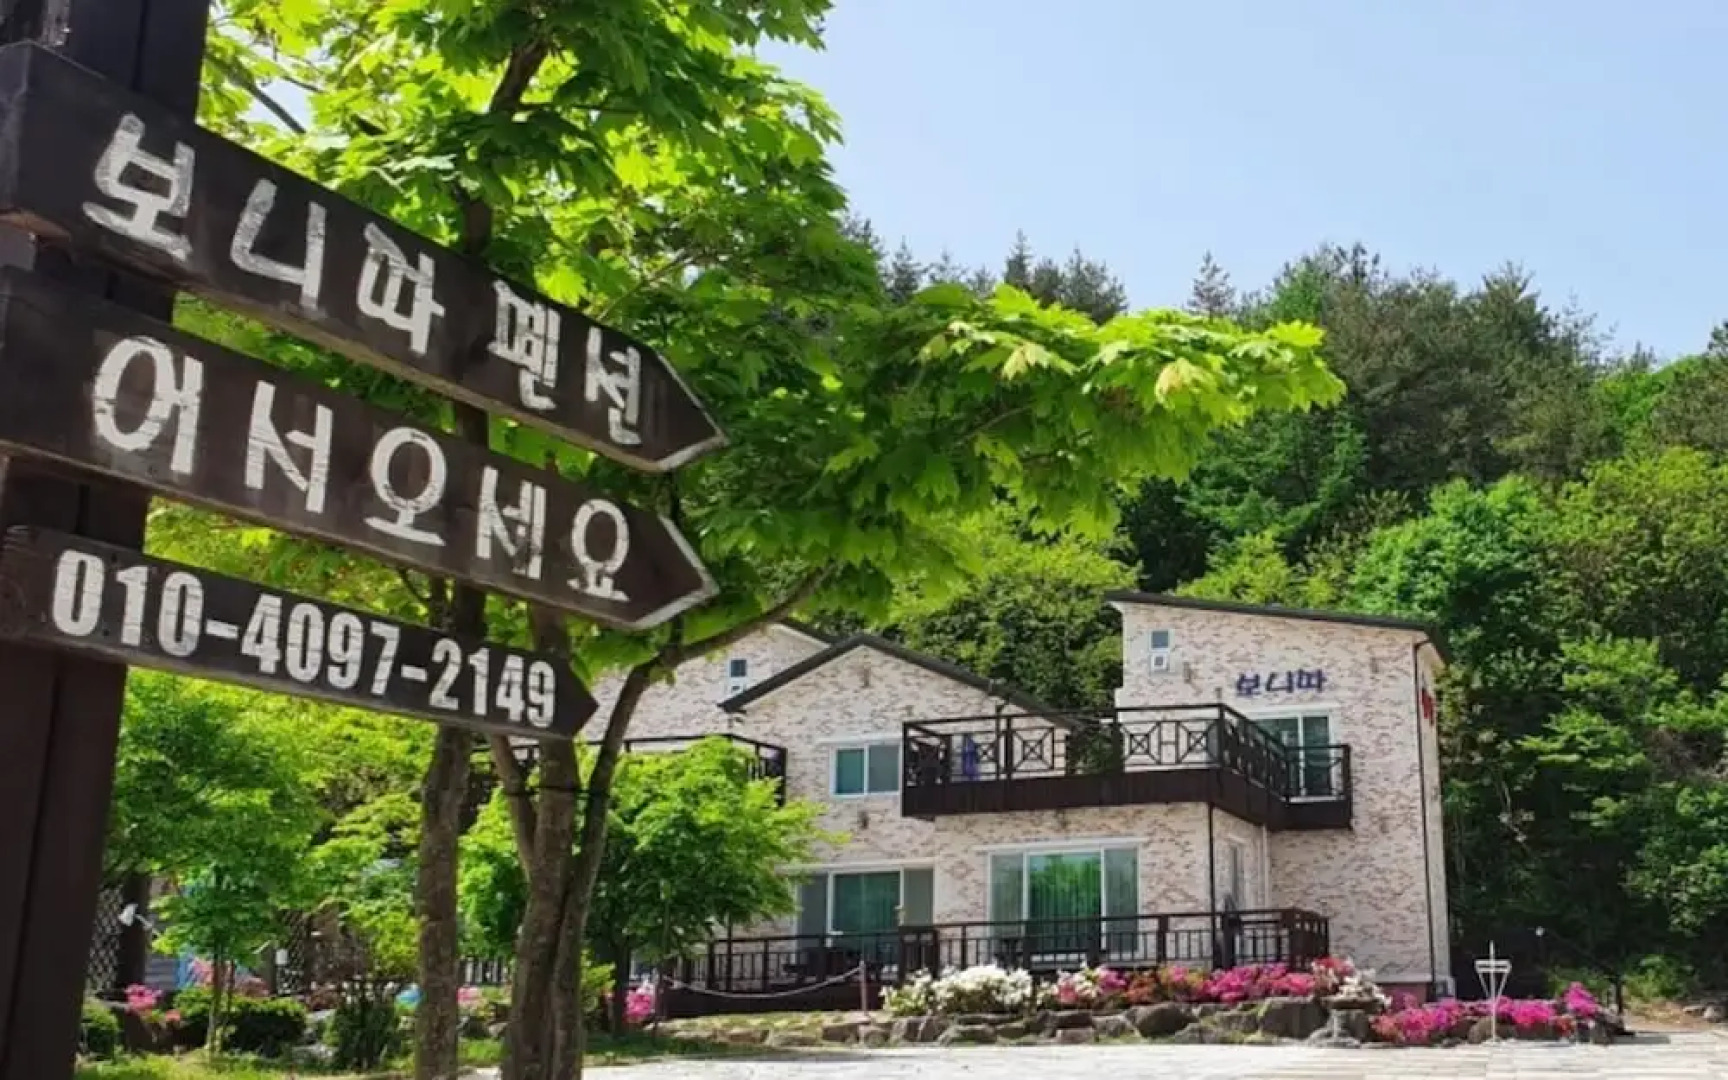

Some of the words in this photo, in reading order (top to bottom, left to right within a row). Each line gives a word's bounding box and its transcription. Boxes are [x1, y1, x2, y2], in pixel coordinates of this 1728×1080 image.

[83, 113, 445, 355] 보니파
[488, 279, 642, 445] 펜션
[93, 335, 630, 601] 어서오세요
[52, 549, 556, 729] 010-4097-2149
[1236, 668, 1327, 696] 보니파
